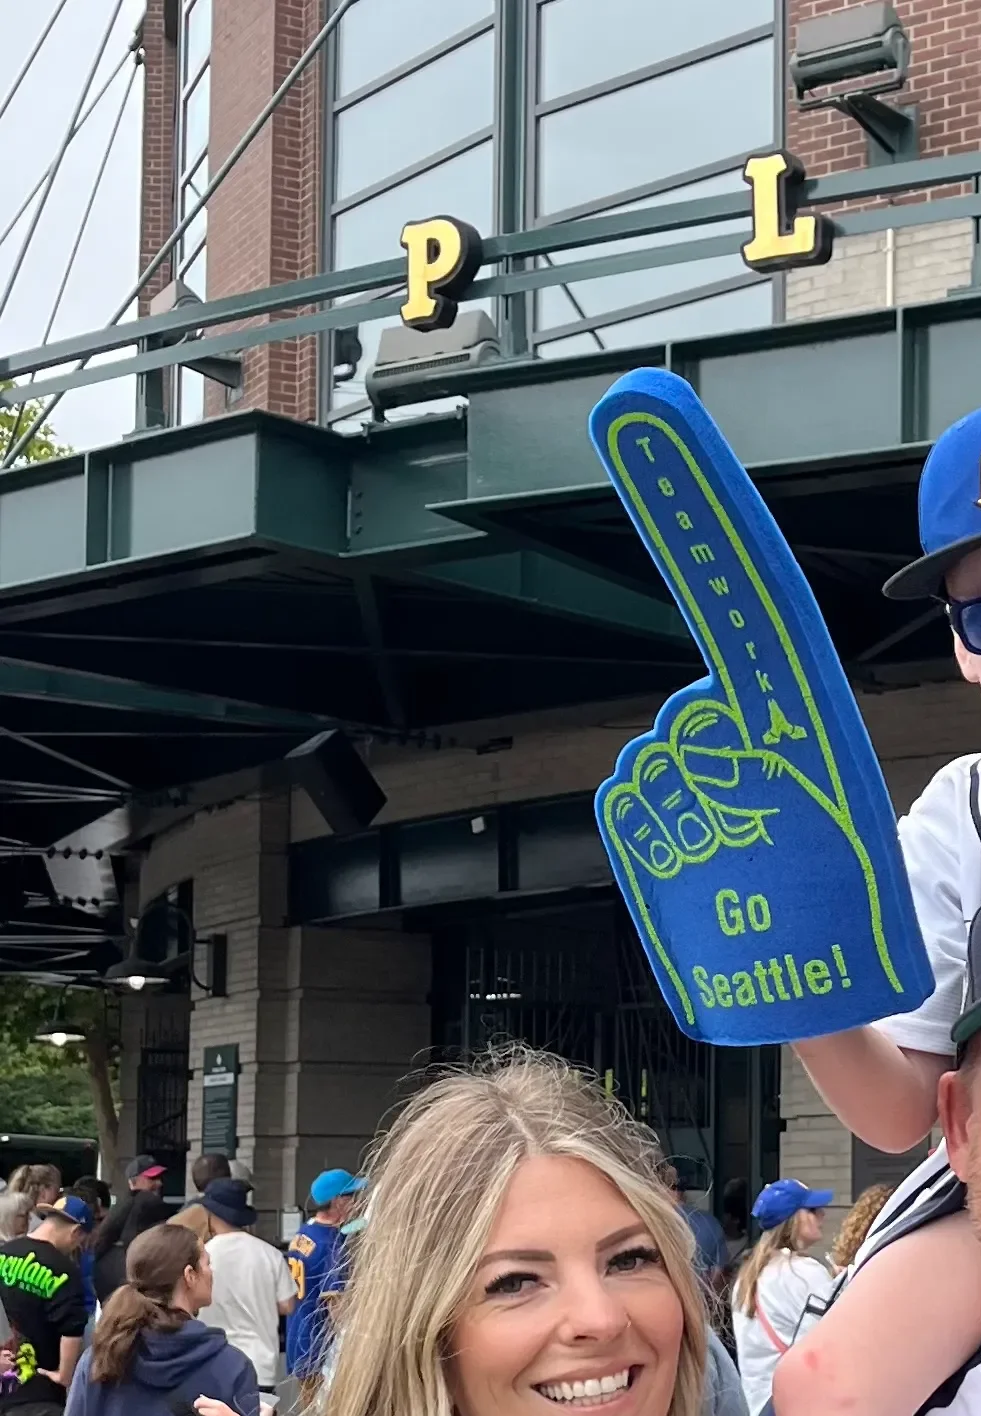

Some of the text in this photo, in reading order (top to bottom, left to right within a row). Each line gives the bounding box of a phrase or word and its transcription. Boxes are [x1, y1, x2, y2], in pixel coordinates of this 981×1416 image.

[636, 436, 774, 693] Teamwork
[715, 888, 772, 936] Go
[692, 944, 851, 1008] Seattle!
